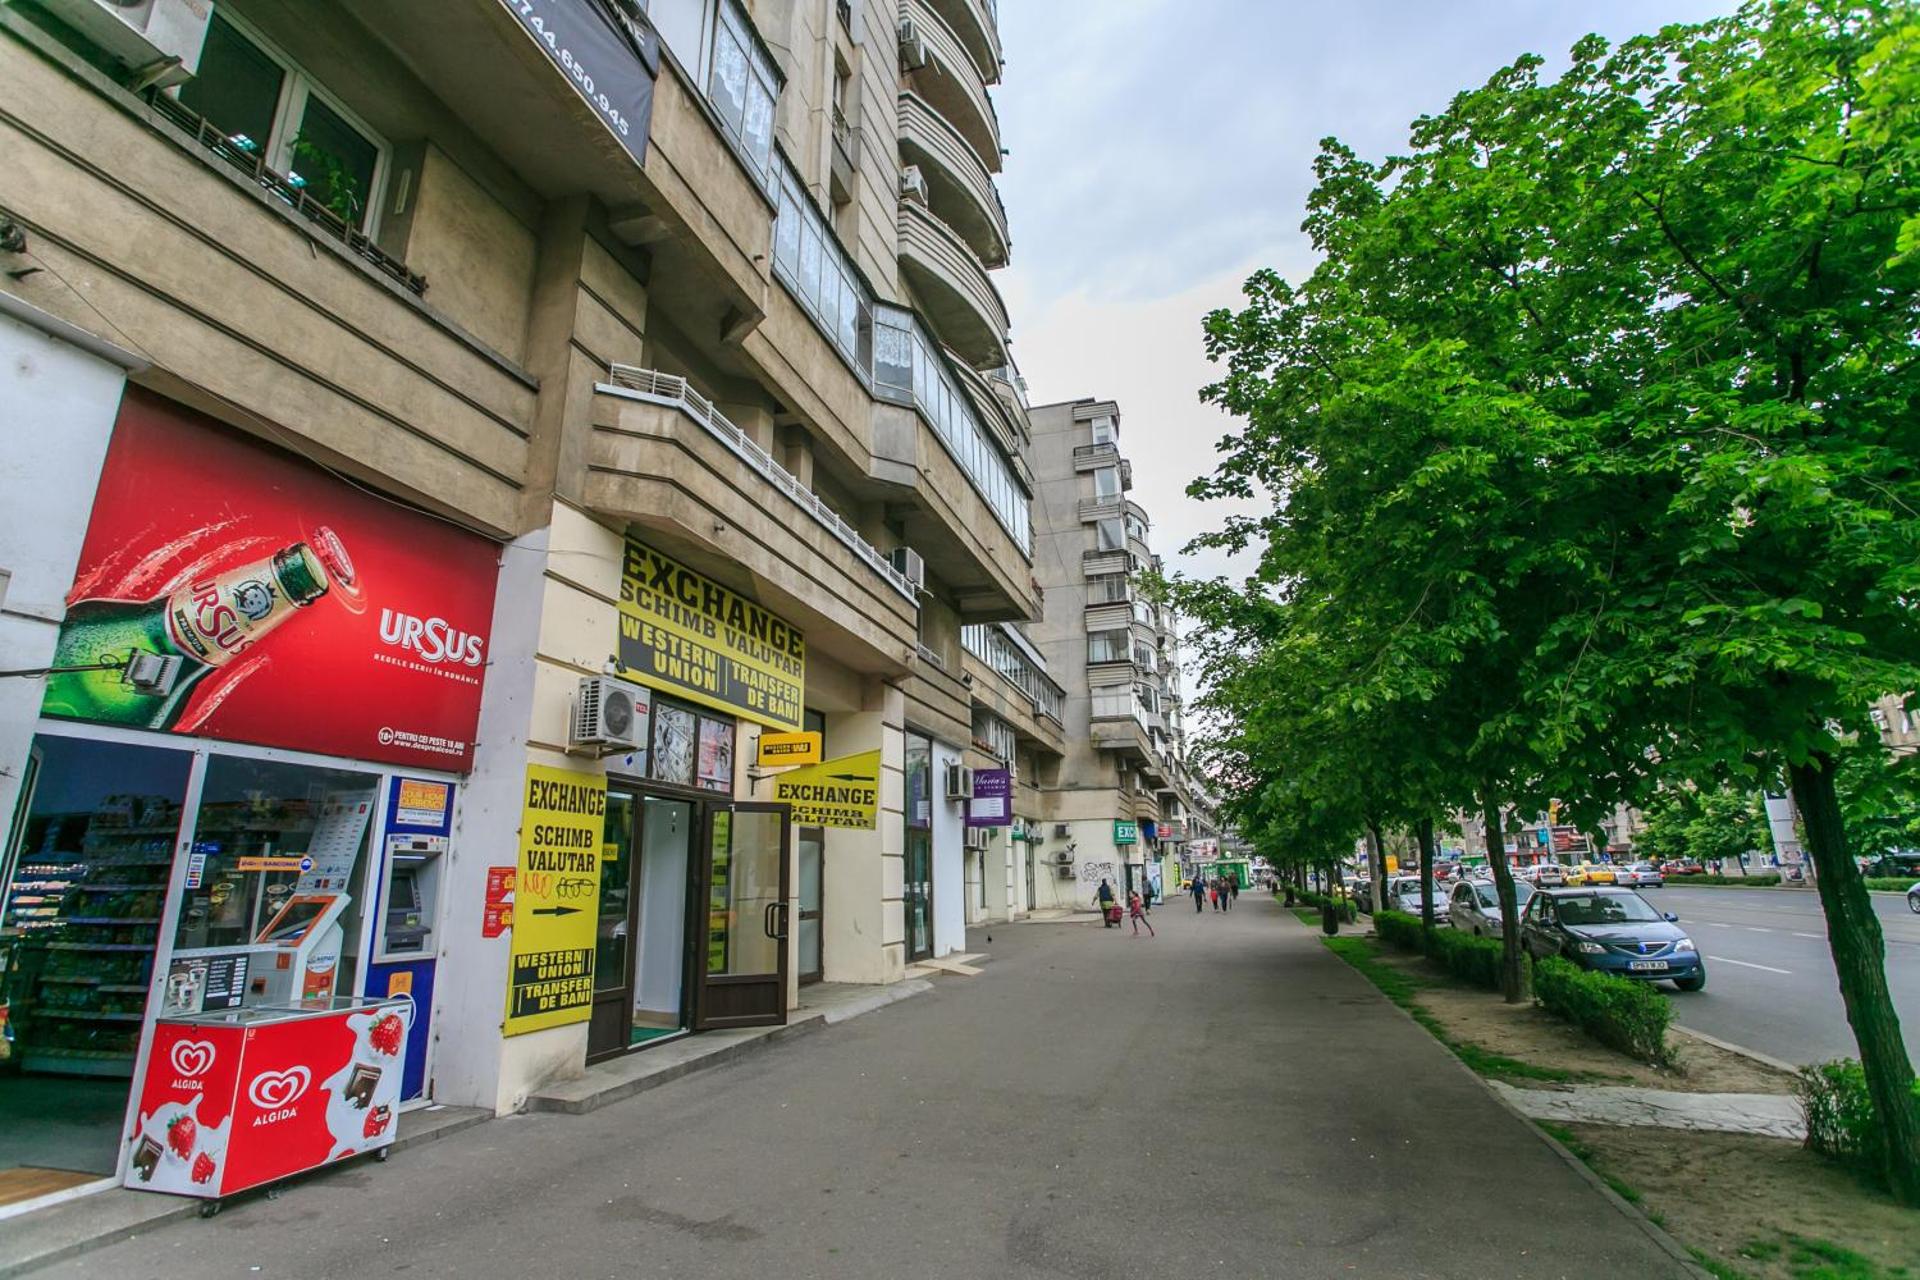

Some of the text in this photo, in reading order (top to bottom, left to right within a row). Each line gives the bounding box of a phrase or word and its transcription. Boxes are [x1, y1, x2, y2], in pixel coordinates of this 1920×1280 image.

[510, 0, 630, 136] 744.650.945
[622, 540, 804, 659] EXCHANGE
[379, 607, 484, 667] URSUS
[620, 579, 801, 678] SCHIMB VALUTAR
[620, 613, 717, 672] WESTERN
[654, 651, 717, 693] UNION
[731, 662, 800, 704] TRANSFER
[748, 687, 800, 722] DE BANI
[529, 779, 605, 816] EXCHANGE
[778, 784, 875, 805] EXCHANGE
[534, 825, 594, 848] SCHIMB
[528, 850, 595, 872] VALUTAR
[517, 952, 583, 968] WESTERN
[538, 964, 582, 980] UNION
[525, 978, 591, 999] TRANSFER
[539, 991, 590, 1010] DE BANI
[171, 1079, 203, 1090] ALGIDA
[253, 1109, 298, 1127] ALGIDA
